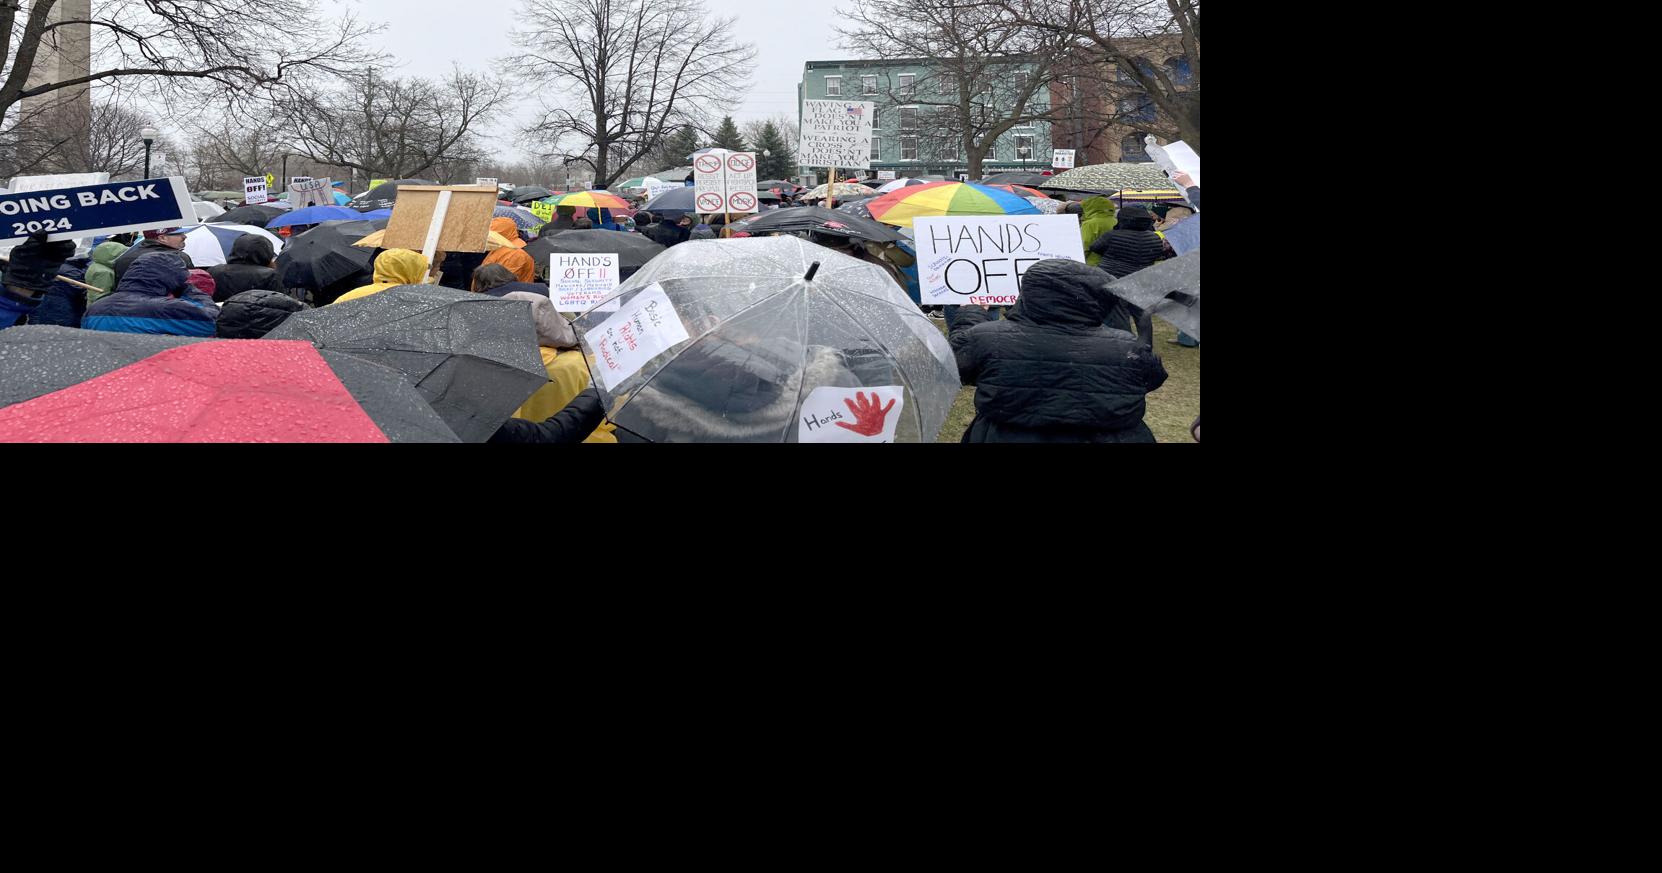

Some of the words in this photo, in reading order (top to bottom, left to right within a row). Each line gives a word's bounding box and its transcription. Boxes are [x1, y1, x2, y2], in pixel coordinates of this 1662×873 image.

[803, 135, 856, 143] WEARING
[800, 159, 861, 167] CHRISTIAN
[77, 183, 160, 207] BACK
[300, 181, 320, 191] USA
[12, 217, 72, 235] 2024
[930, 223, 1041, 254] HANDS
[560, 256, 612, 267] HAND'S
[645, 300, 662, 327] Basic
[619, 321, 638, 352] Rights
[803, 409, 843, 431] Hands
